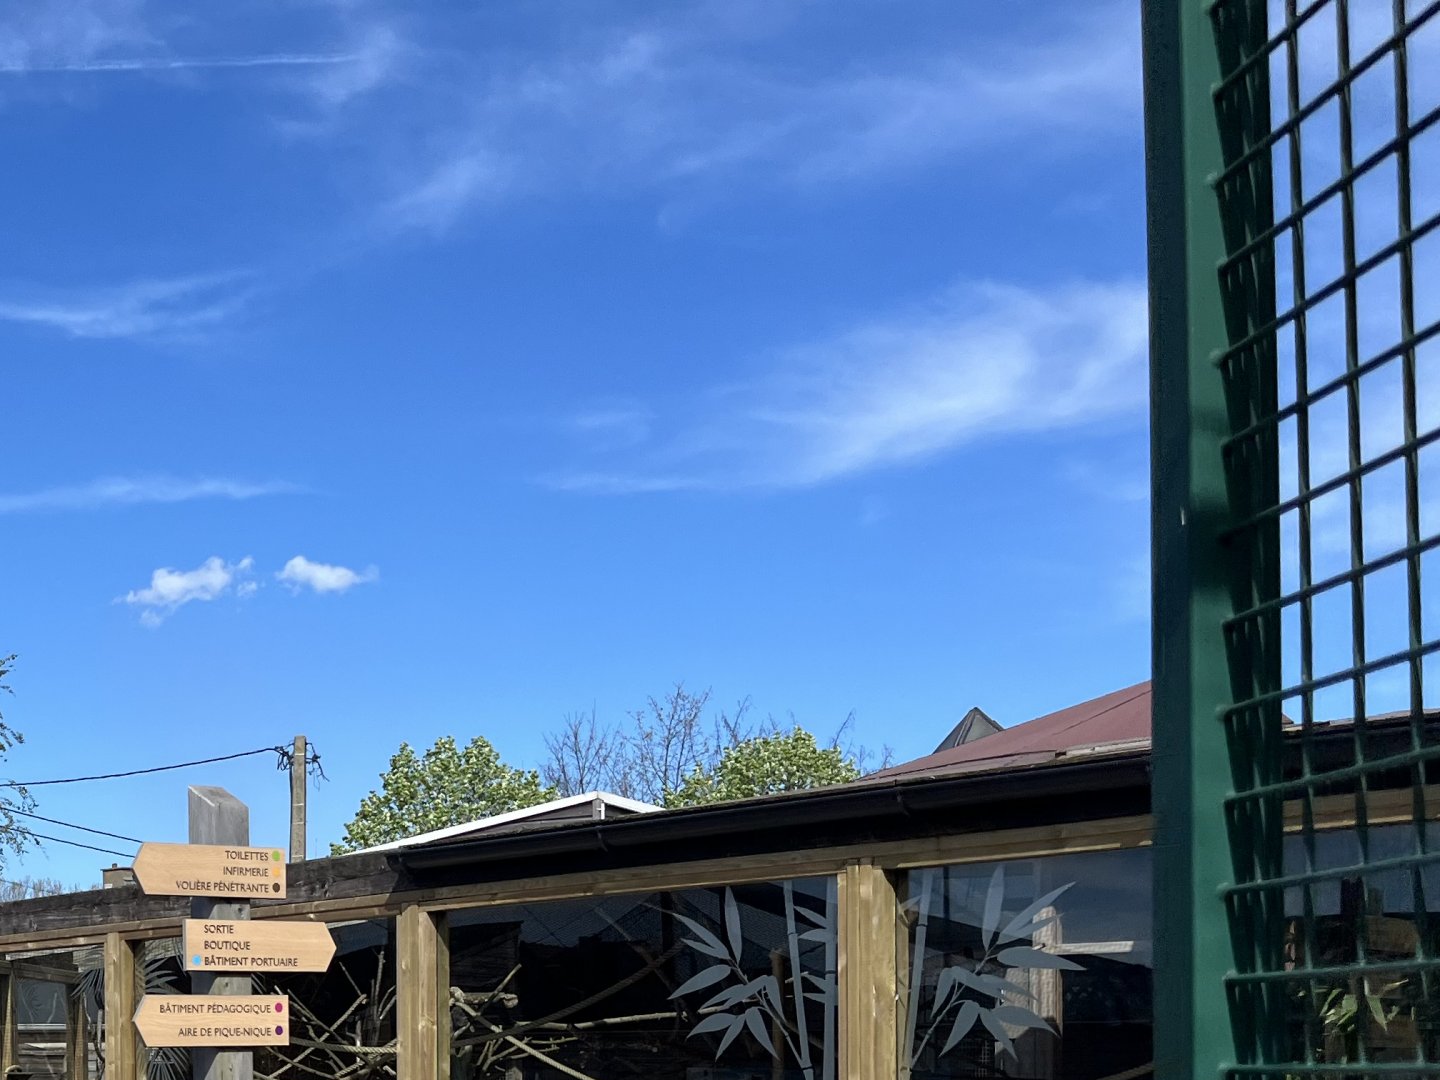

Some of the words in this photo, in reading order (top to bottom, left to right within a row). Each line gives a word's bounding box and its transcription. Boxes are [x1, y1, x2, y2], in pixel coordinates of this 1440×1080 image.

[225, 850, 269, 861] TOILETTES
[223, 866, 269, 877] INFIRMERIE
[176, 879, 211, 891] VOLIÈRE
[213, 880, 269, 893] PÉNÉTRANTE
[204, 924, 234, 934] SORTIE
[204, 940, 251, 951] BOUTIQUE
[204, 954, 247, 966] BÂTIMENT
[250, 957, 298, 967] PORTUAIRE
[159, 1001, 205, 1014] BÂTIMENT
[207, 1003, 271, 1015] PÉDAGOGIQUE
[178, 1027, 197, 1037] AIRE
[200, 1027, 211, 1037] DE
[214, 1027, 271, 1038] PIQUE-NIQUE
